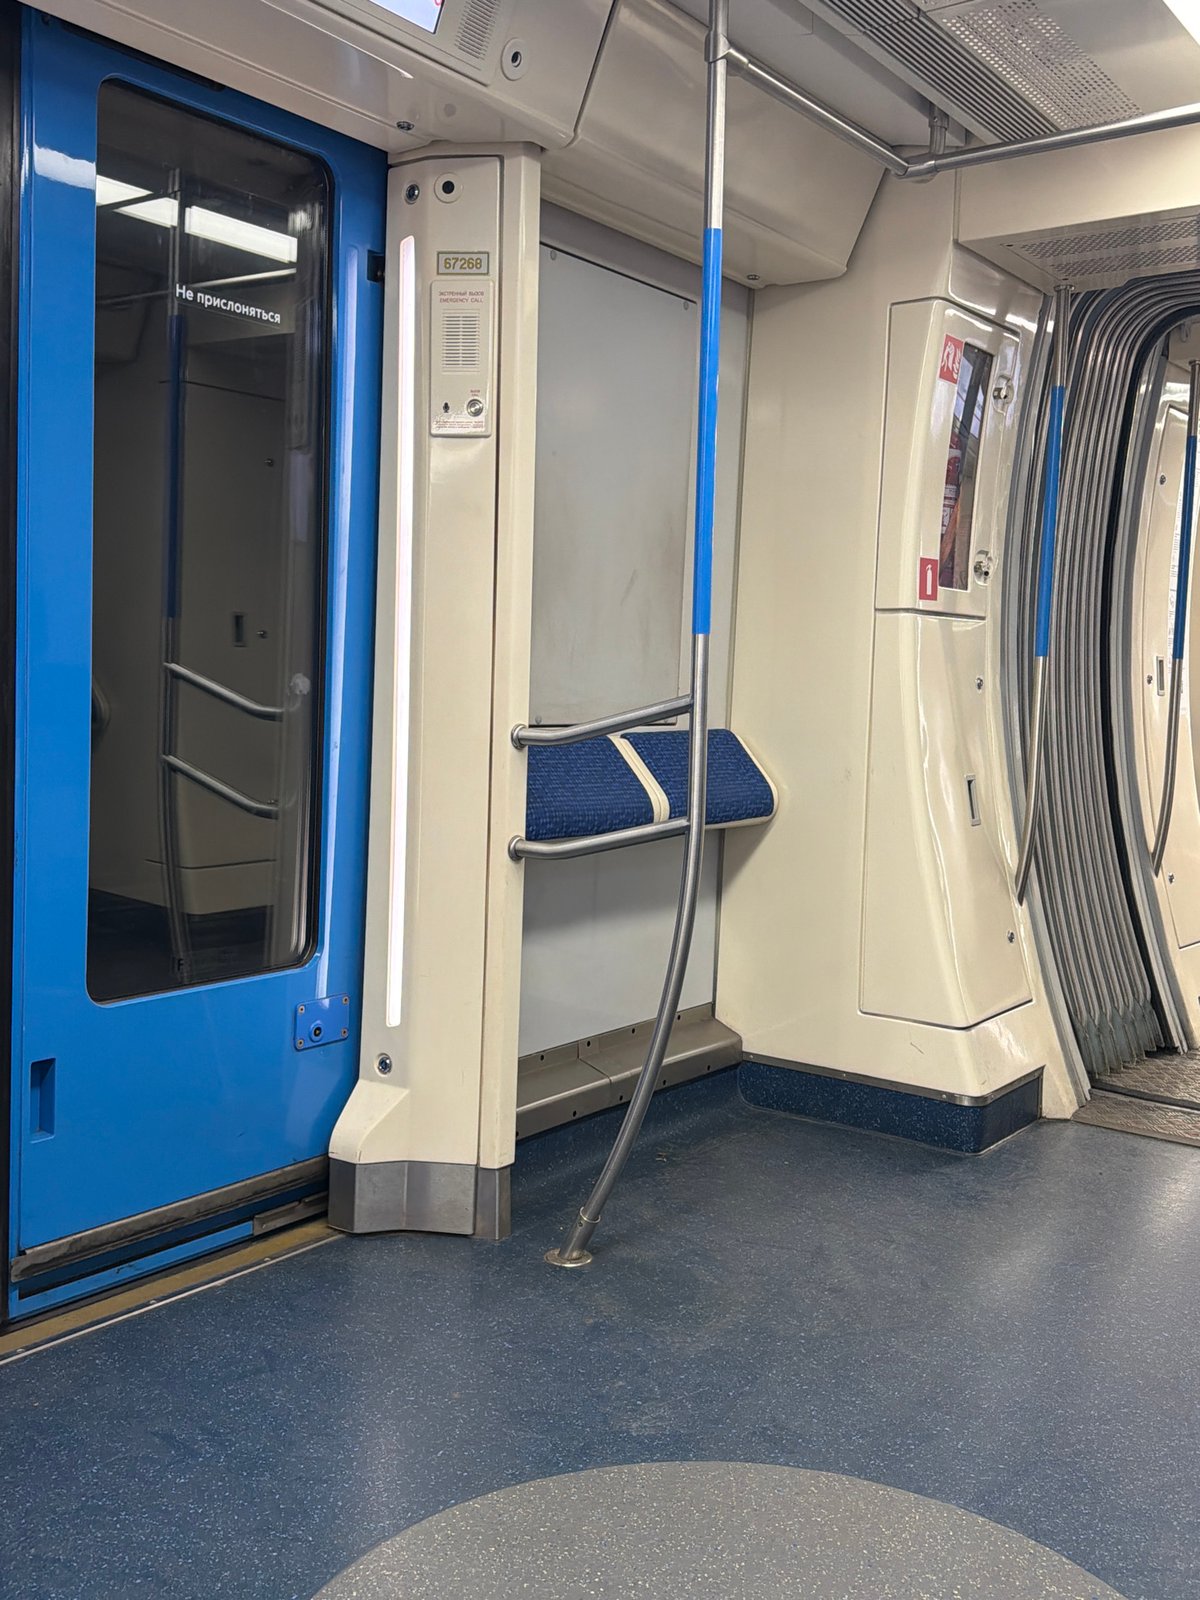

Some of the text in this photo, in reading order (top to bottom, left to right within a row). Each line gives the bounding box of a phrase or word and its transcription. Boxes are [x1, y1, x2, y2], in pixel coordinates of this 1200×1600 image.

[444, 257, 482, 270] 67268
[175, 283, 281, 324] Не прислоняться
